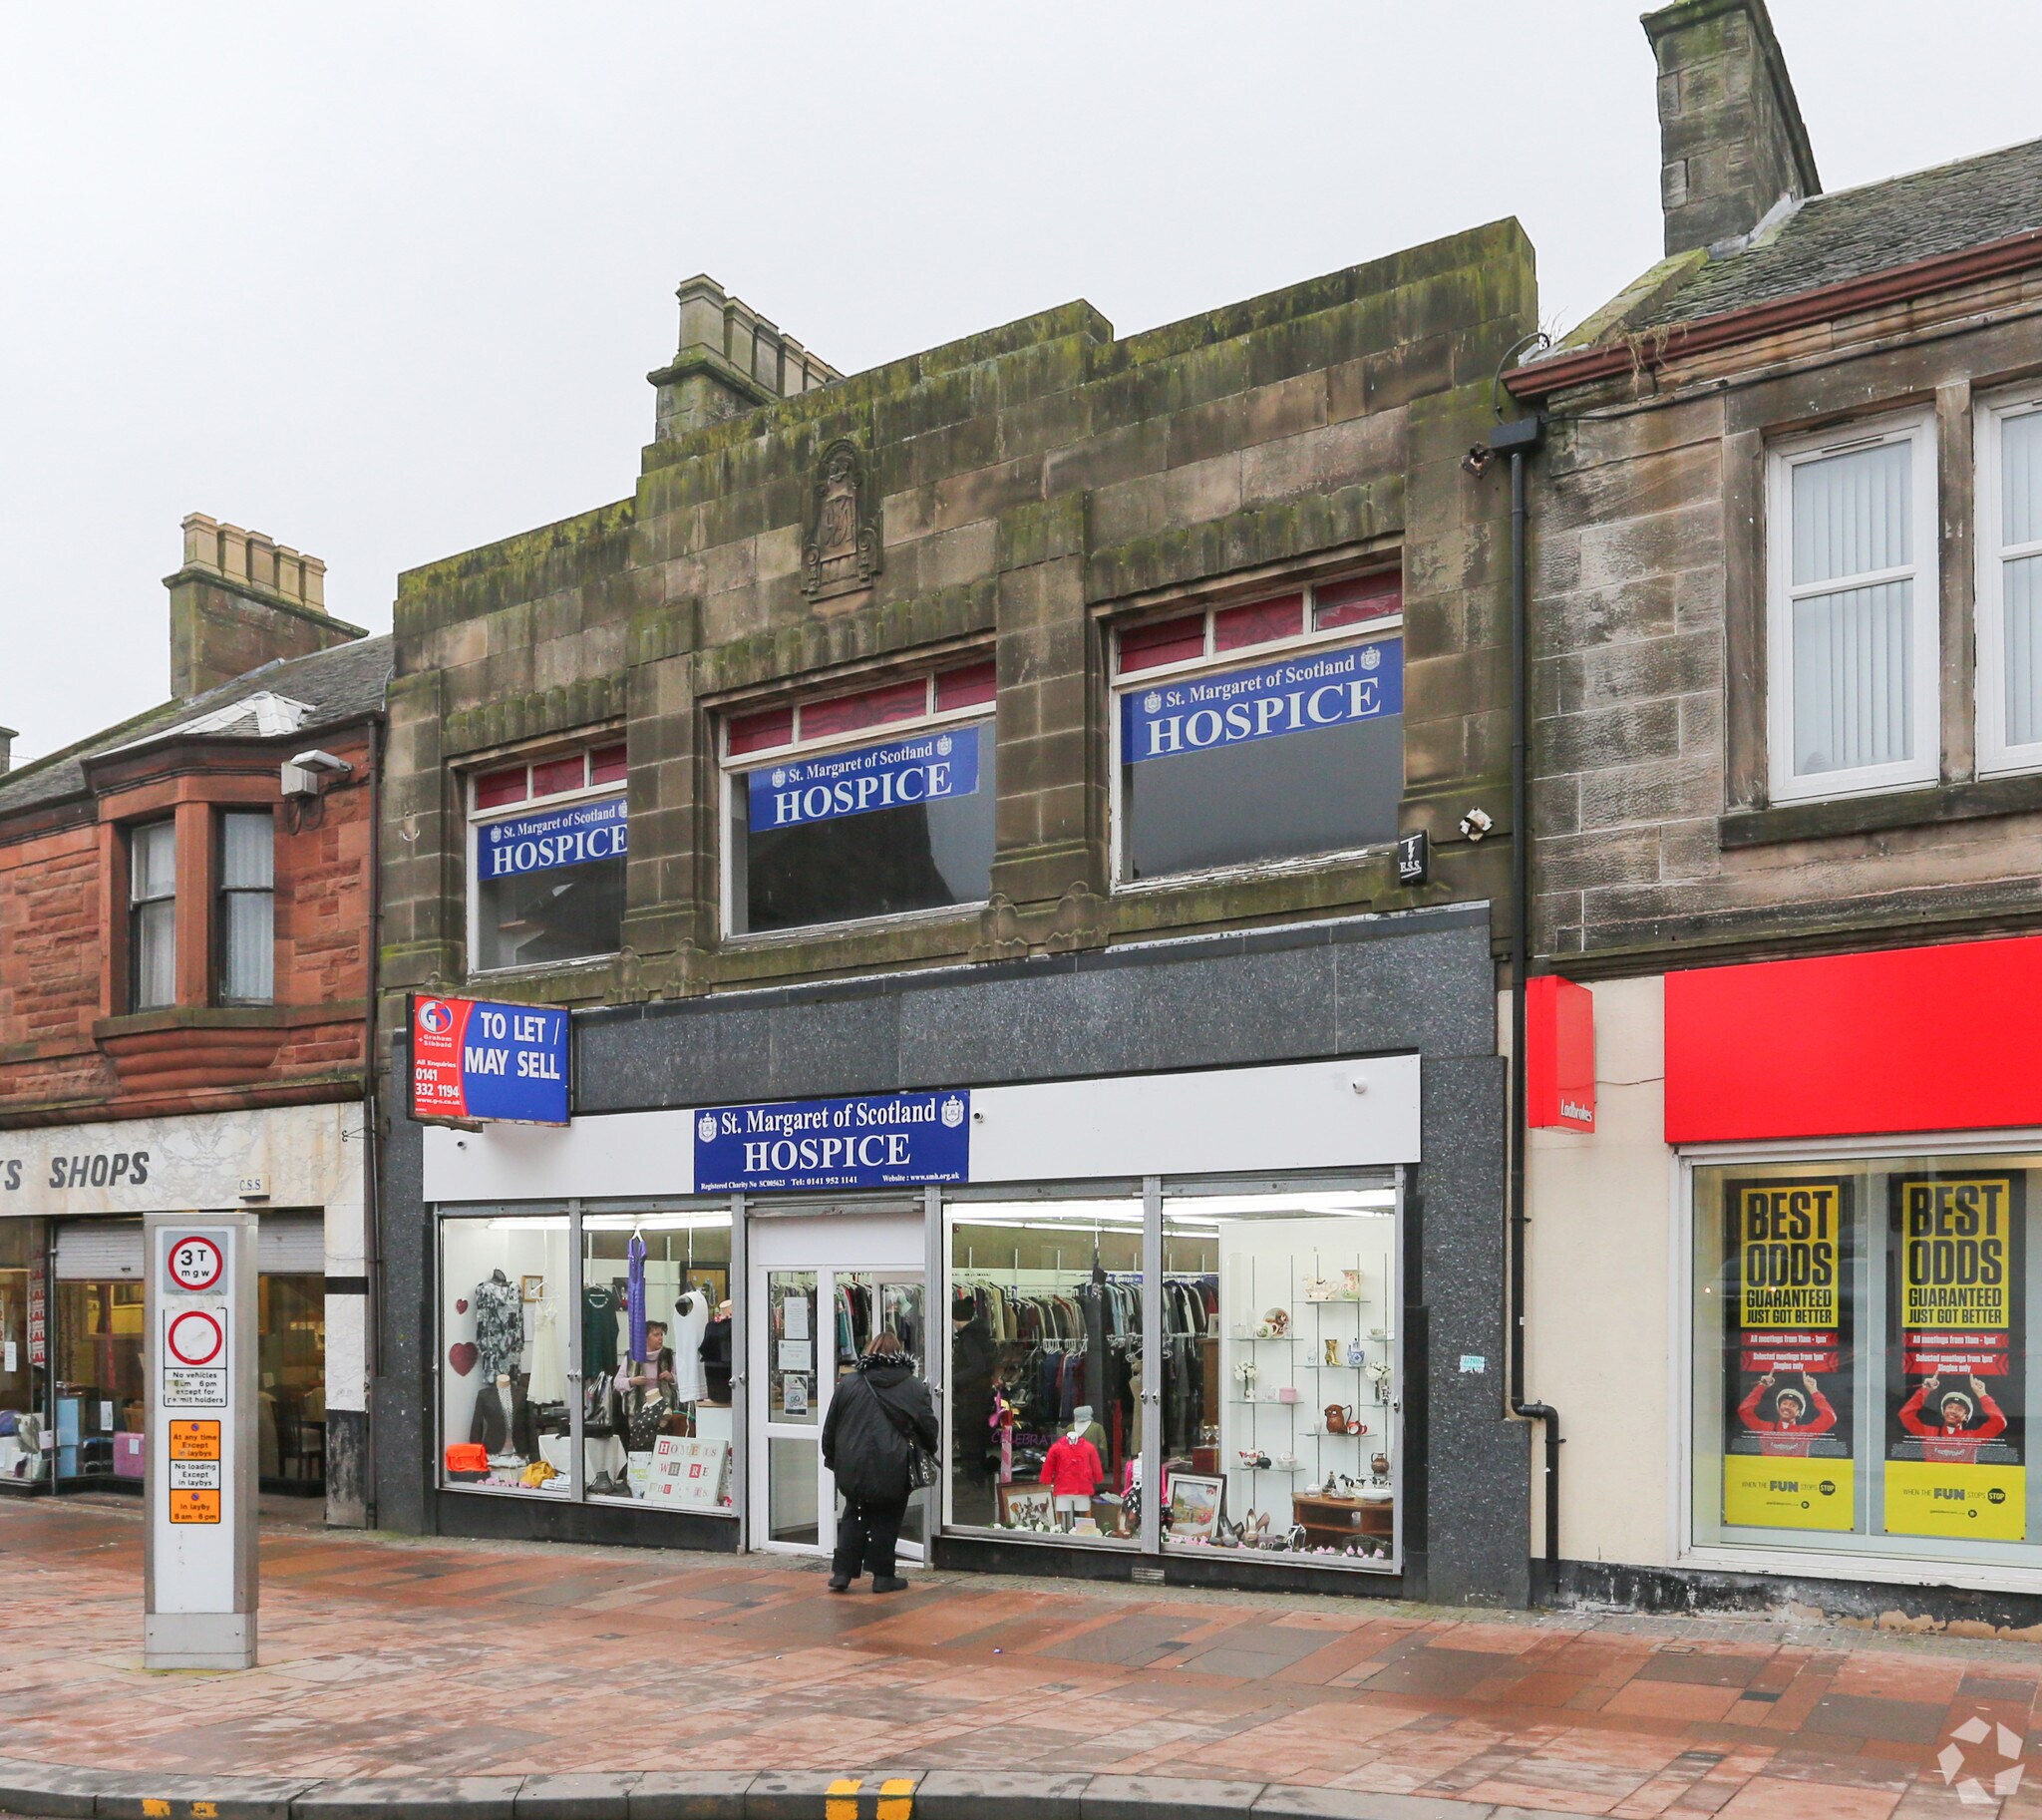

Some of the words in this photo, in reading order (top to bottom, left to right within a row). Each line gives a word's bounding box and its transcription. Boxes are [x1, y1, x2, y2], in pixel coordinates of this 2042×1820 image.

[1166, 691, 1186, 708] St.
[1190, 675, 1261, 701] Margaret
[1266, 669, 1283, 688] of
[1285, 655, 1355, 683] Scotland
[1146, 677, 1381, 756] HOSPICE
[789, 769, 804, 783] St.
[807, 757, 861, 780] Margaret
[864, 752, 877, 769] of
[879, 742, 933, 765] Scotland
[774, 762, 952, 825] HOSPICE
[504, 826, 515, 838] St.
[517, 818, 560, 836] Margaret
[562, 814, 572, 826] of
[574, 806, 615, 825] Scotland
[492, 824, 627, 875] HOSPICE
[480, 1011, 507, 1040] TO
[513, 1014, 546, 1043] LET
[553, 1018, 560, 1045] /
[427, 1059, 457, 1068] Enquiries
[465, 1046, 510, 1075] MAY
[516, 1050, 560, 1080] SELL
[415, 1068, 438, 1082] 0141
[415, 1082, 434, 1096] 332
[437, 1084, 460, 1098] 1194
[722, 1112, 742, 1135] St.
[746, 1106, 829, 1138] Margaret
[834, 1103, 853, 1128] of
[855, 1097, 936, 1126] Scotland
[743, 1134, 910, 1173] HOSPICE
[0, 1159, 23, 1191] S
[49, 1151, 150, 1189] SHOPS
[701, 1182, 728, 1191] Registered
[728, 1181, 749, 1190] Charity
[806, 1177, 824, 1186] 0141
[1747, 1191, 1833, 1241] BEST
[1909, 1185, 2003, 1237] BEST
[180, 1250, 192, 1266] 3
[197, 1250, 206, 1262] T
[1747, 1243, 1833, 1287] ODDS
[1909, 1239, 2002, 1285] ODDS
[29, 1289, 46, 1300] SAL
[1747, 1289, 1832, 1307] GUARANTEED
[1908, 1287, 2002, 1307] GUARANTEED
[29, 1310, 46, 1322] SAL
[1747, 1309, 1771, 1323] JUST
[1773, 1309, 1793, 1323] GOT
[1795, 1309, 1832, 1323] BETTER
[1908, 1308, 1934, 1323] JUST
[1937, 1308, 1958, 1323] GOT
[1961, 1308, 2002, 1323] BETTER
[29, 1331, 46, 1343] SAL
[29, 1352, 46, 1363] SAL
[659, 1442, 699, 1456] HOME
[704, 1447, 717, 1456] IS
[660, 1462, 709, 1477] WHRE
[1770, 1480, 1799, 1492] FUN
[1934, 1488, 1965, 1500] FUN
